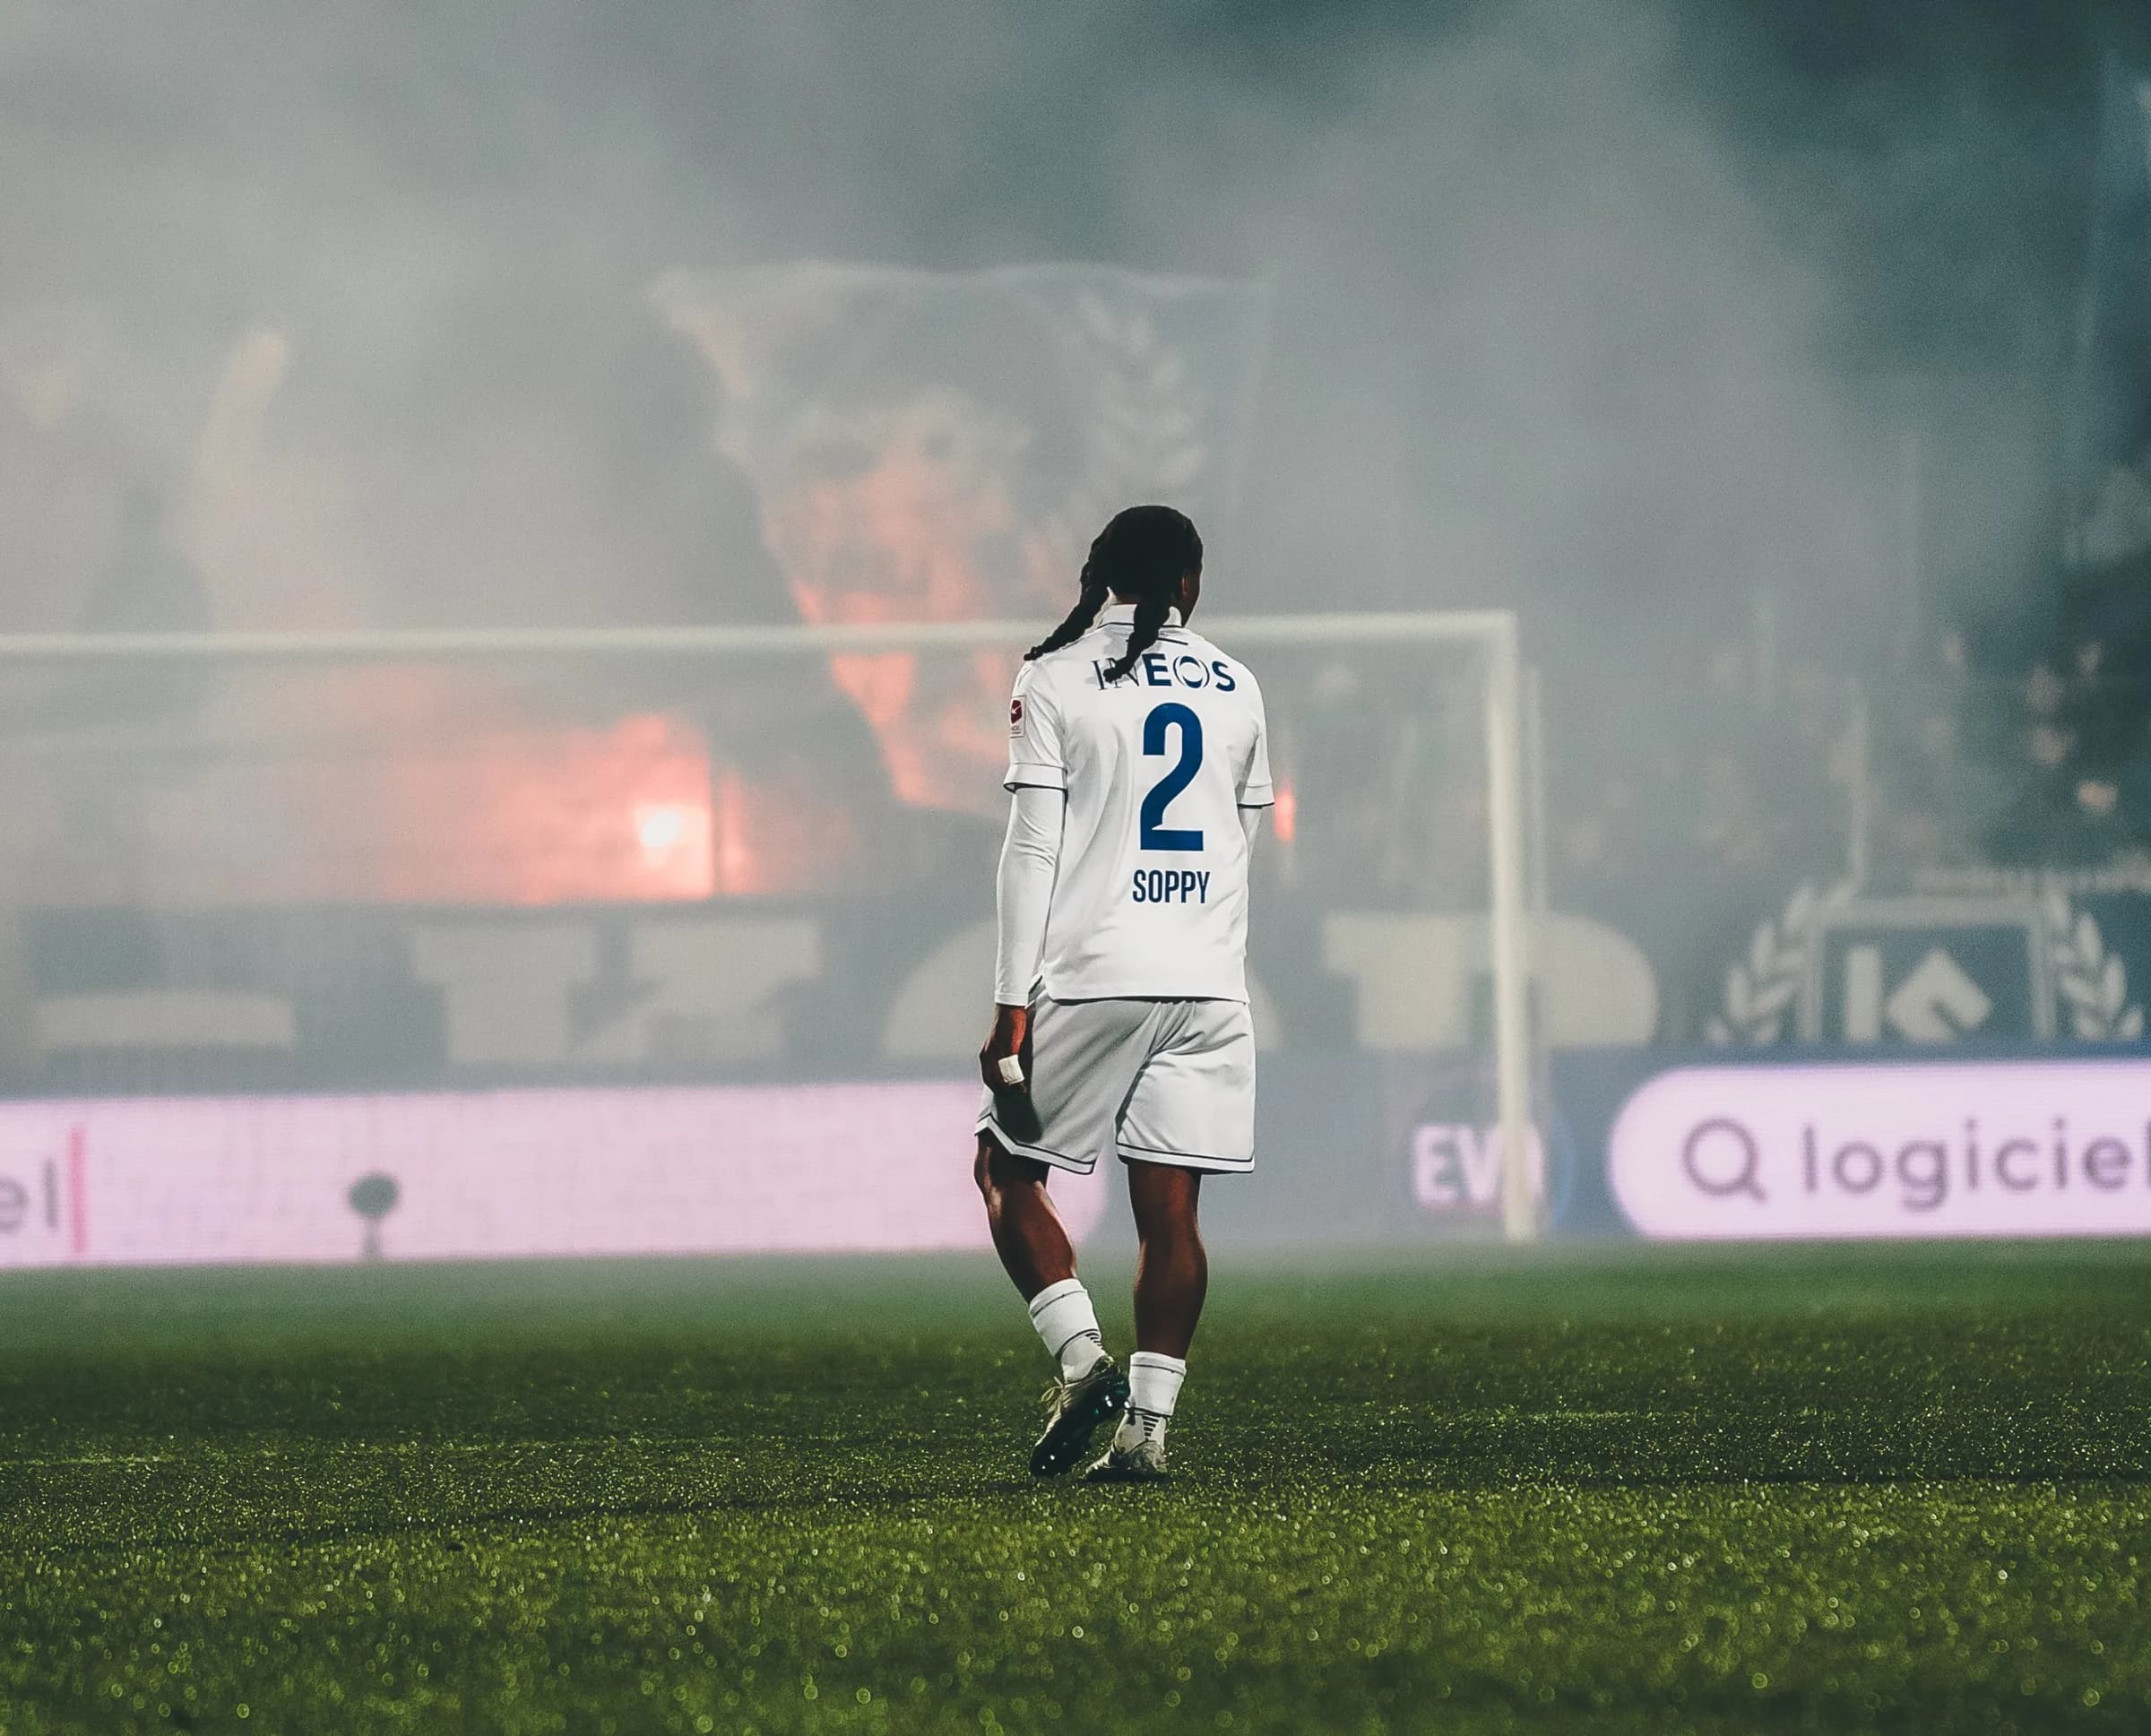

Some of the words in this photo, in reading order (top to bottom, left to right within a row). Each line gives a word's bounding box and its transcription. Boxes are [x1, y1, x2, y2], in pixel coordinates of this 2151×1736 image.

[1140, 702, 1205, 852] 2
[1132, 868, 1211, 904] SOPPY
[1412, 1122, 1545, 1205] EV
